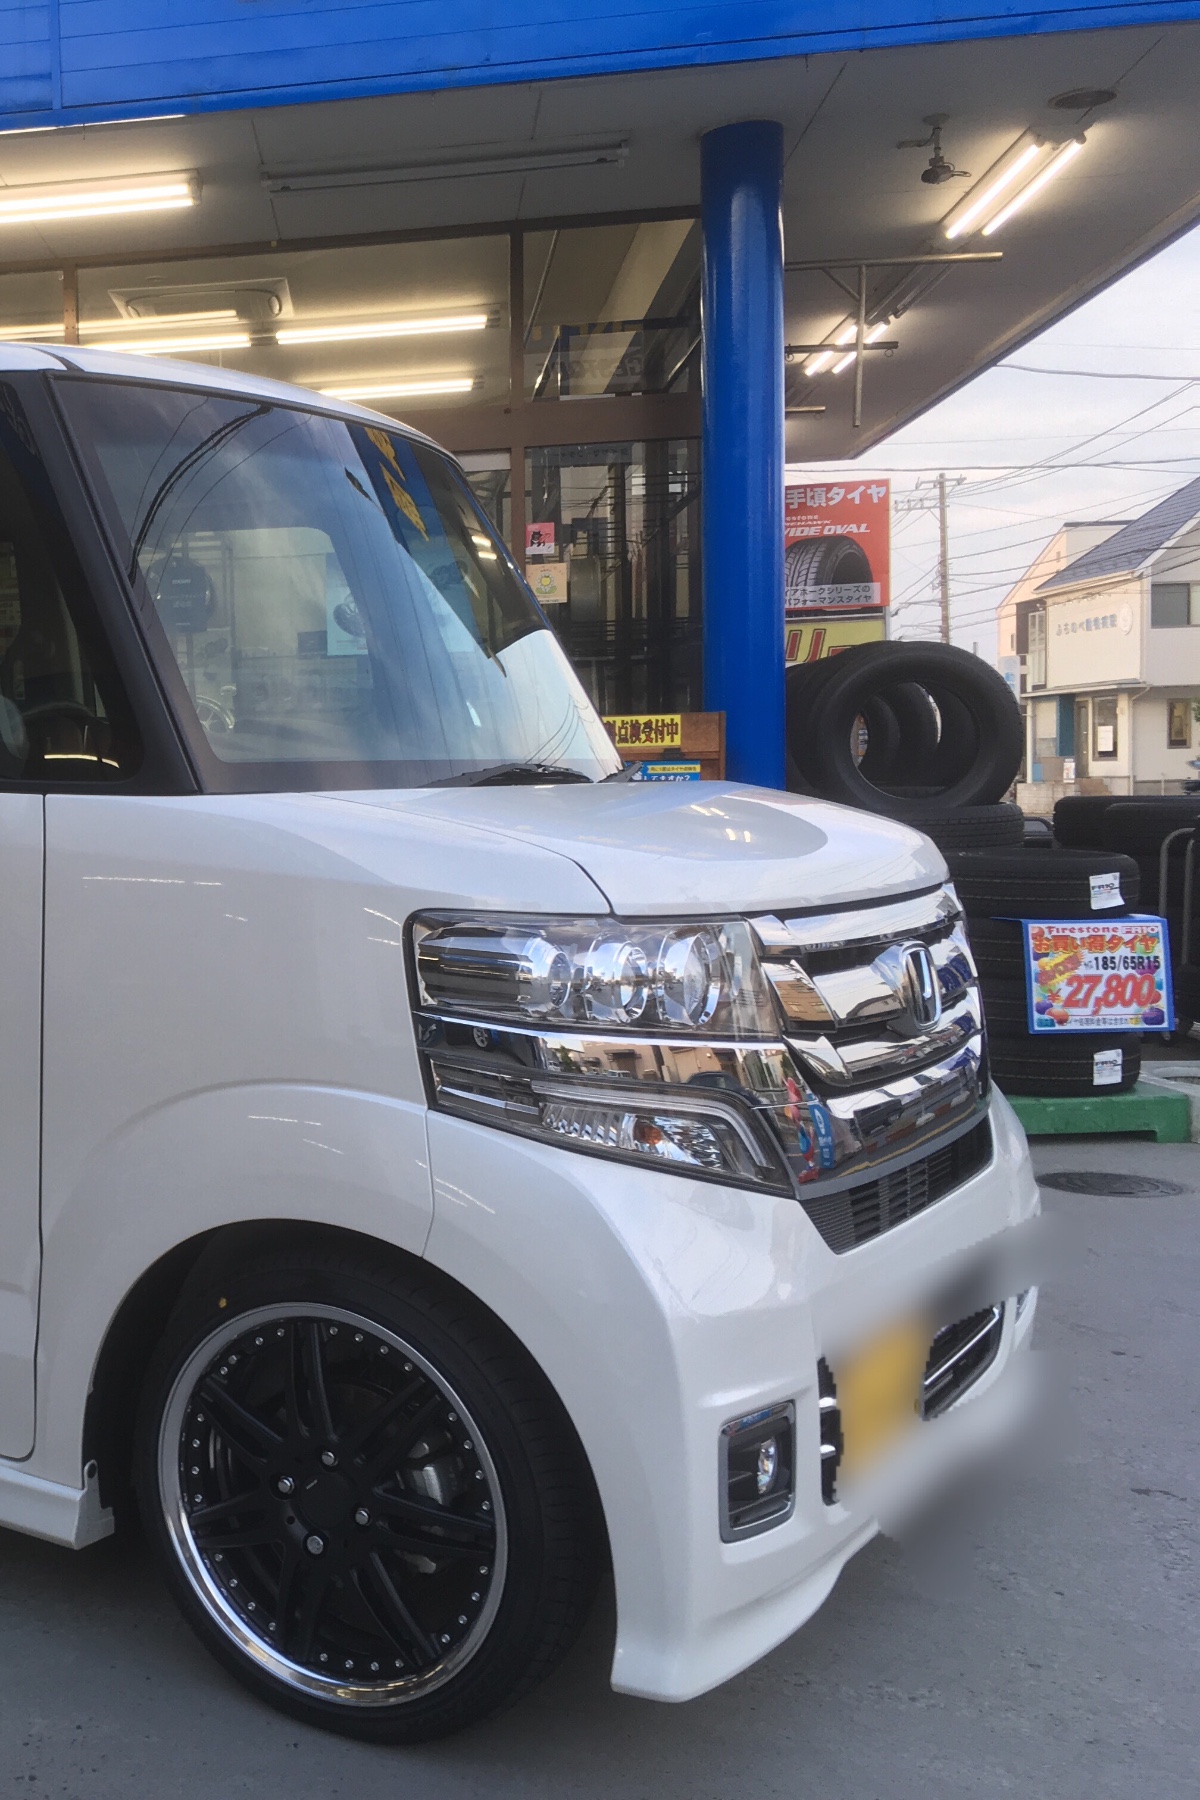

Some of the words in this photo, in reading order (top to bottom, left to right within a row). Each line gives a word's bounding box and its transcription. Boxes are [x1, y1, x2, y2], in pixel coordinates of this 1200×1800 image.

[785, 484, 887, 509] 手頃タイヤ
[823, 523, 871, 535] OVAL
[1045, 926, 1119, 935] Firestone
[1094, 955, 1161, 971] 185/65R15
